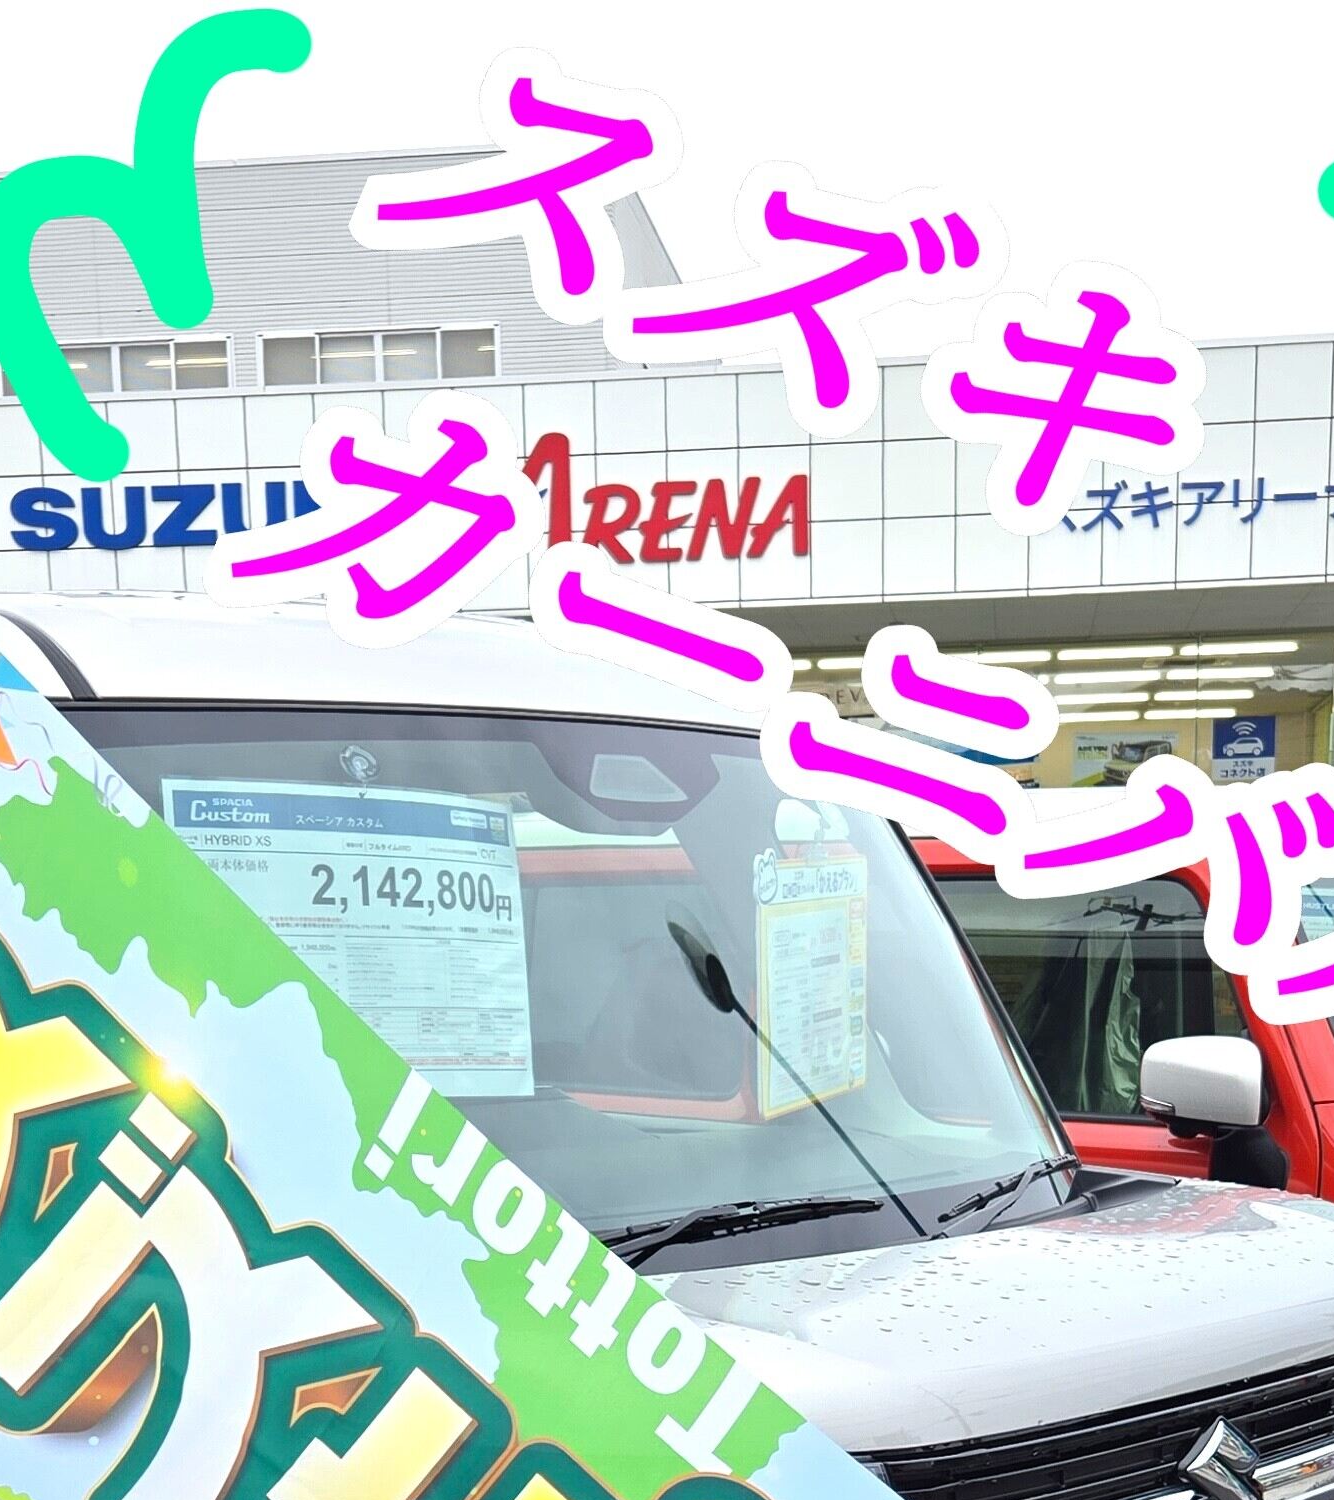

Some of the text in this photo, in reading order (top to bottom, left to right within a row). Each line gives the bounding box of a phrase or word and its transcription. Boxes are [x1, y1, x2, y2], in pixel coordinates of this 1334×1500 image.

[10, 432, 809, 564] SUZU ARENA
[190, 800, 270, 824] Custom
[212, 797, 253, 807] SPACIA
[296, 814, 384, 829] スペーシア カスタム
[204, 835, 252, 847] HYBRID
[255, 836, 272, 847] XS
[311, 863, 513, 922] 2,142,800円
[363, 1068, 762, 1476] Tottori
